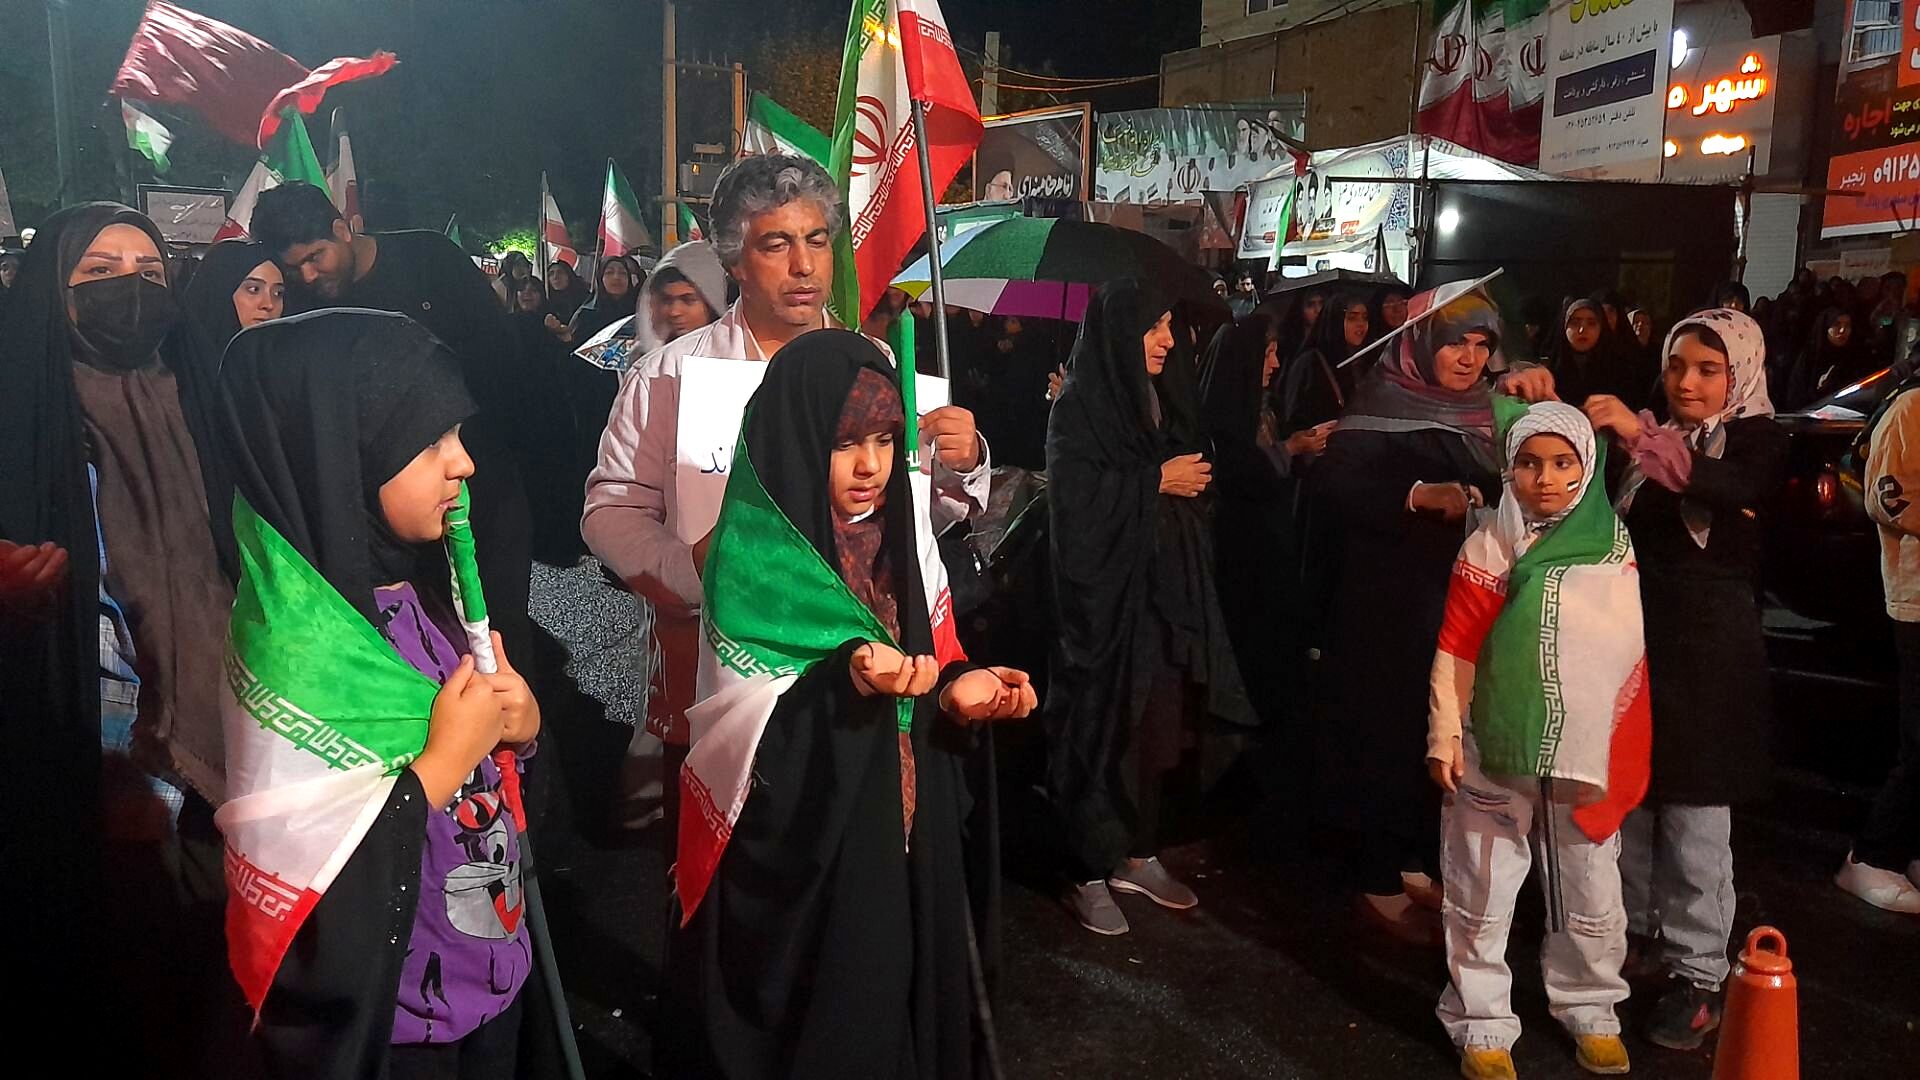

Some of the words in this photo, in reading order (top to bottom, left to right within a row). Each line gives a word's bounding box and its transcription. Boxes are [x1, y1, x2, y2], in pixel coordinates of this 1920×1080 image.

[1600, 35, 1615, 53] سال
[1692, 55, 1767, 116] شهر
[1843, 97, 1892, 141] اجاره
[1892, 99, 1911, 113] جهت
[1840, 166, 1866, 190] رنجبر
[1878, 475, 1912, 518] 2
